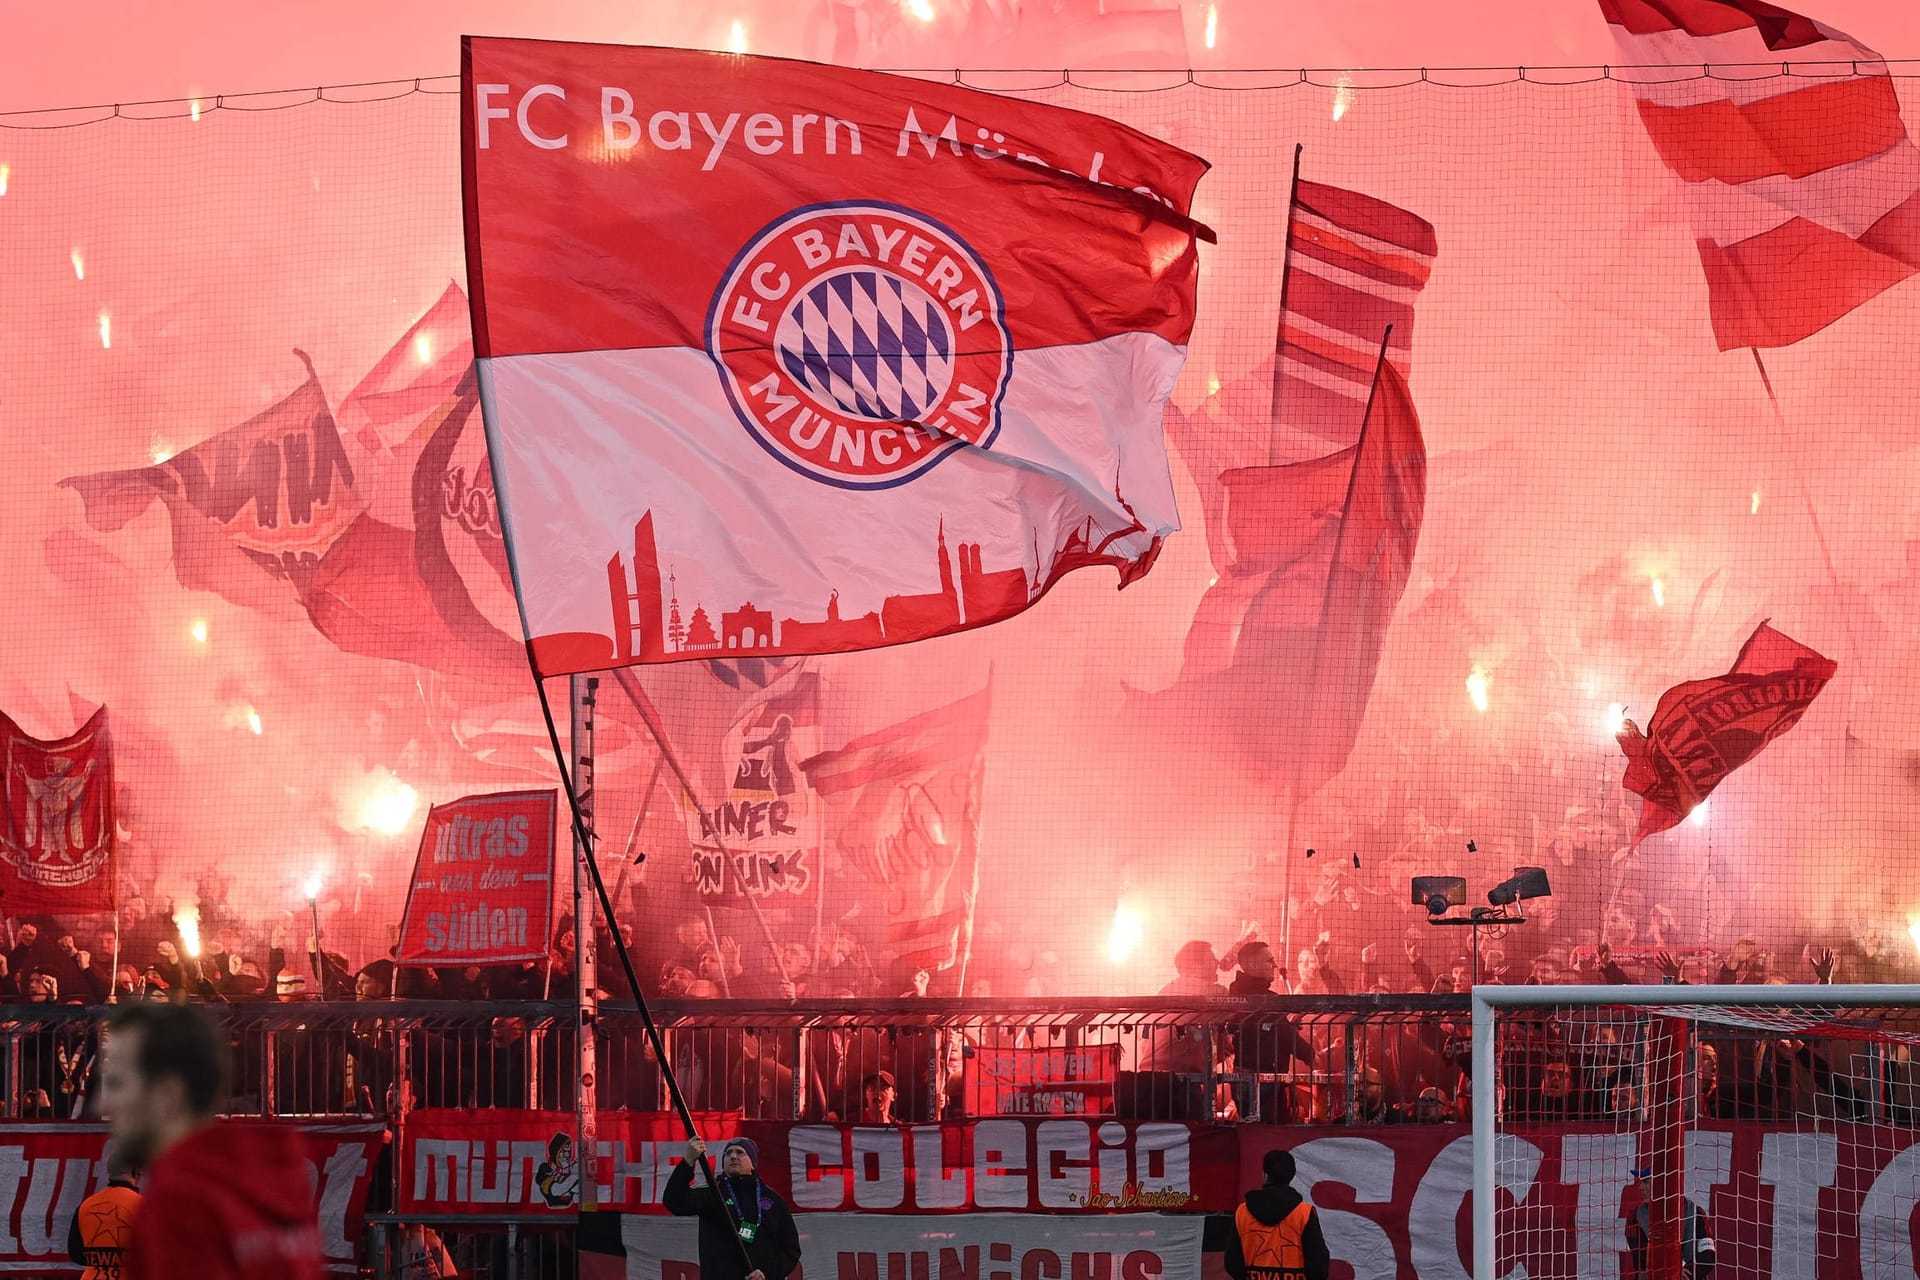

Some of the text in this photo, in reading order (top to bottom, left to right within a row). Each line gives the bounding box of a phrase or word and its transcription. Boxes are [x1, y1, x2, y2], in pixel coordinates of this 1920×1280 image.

[476, 83, 568, 150] FC
[601, 86, 861, 171] Bayern
[731, 223, 984, 333] FC BAYERN
[748, 372, 989, 467] MÜNCHN
[434, 814, 529, 864] ultras
[479, 862, 520, 889] dem
[425, 902, 529, 952] süden
